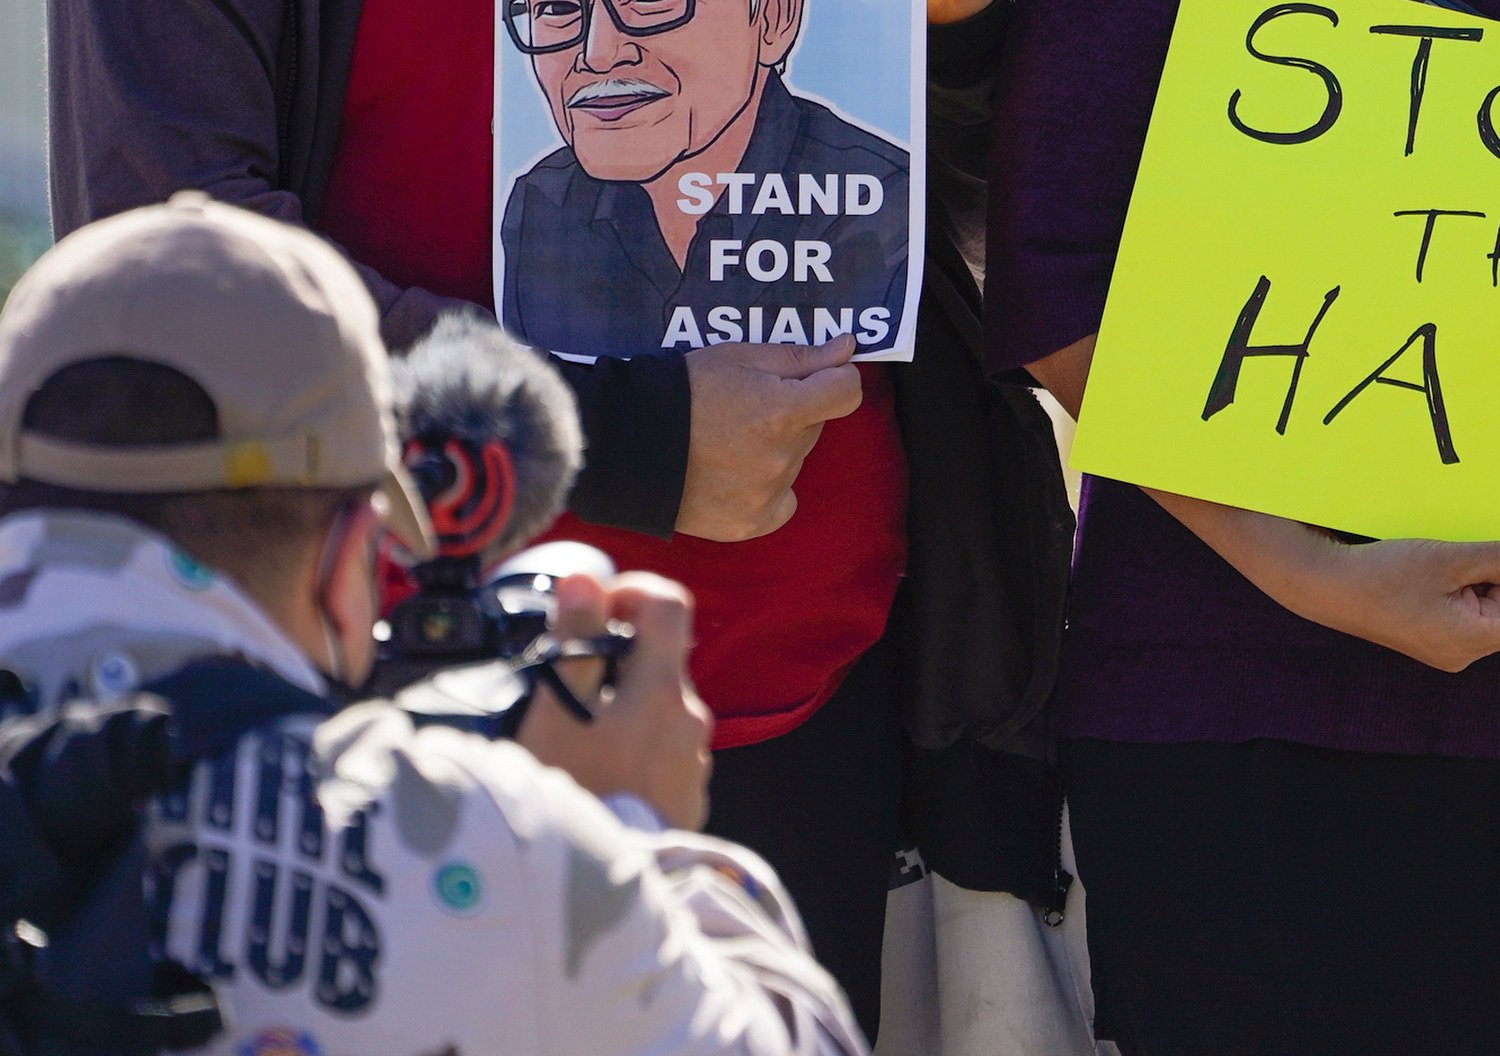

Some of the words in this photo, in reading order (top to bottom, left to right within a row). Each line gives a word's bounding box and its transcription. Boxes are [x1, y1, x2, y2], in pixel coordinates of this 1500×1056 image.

[676, 171, 884, 216] STAND
[709, 239, 834, 282] FOR
[661, 306, 891, 349] ASIANS
